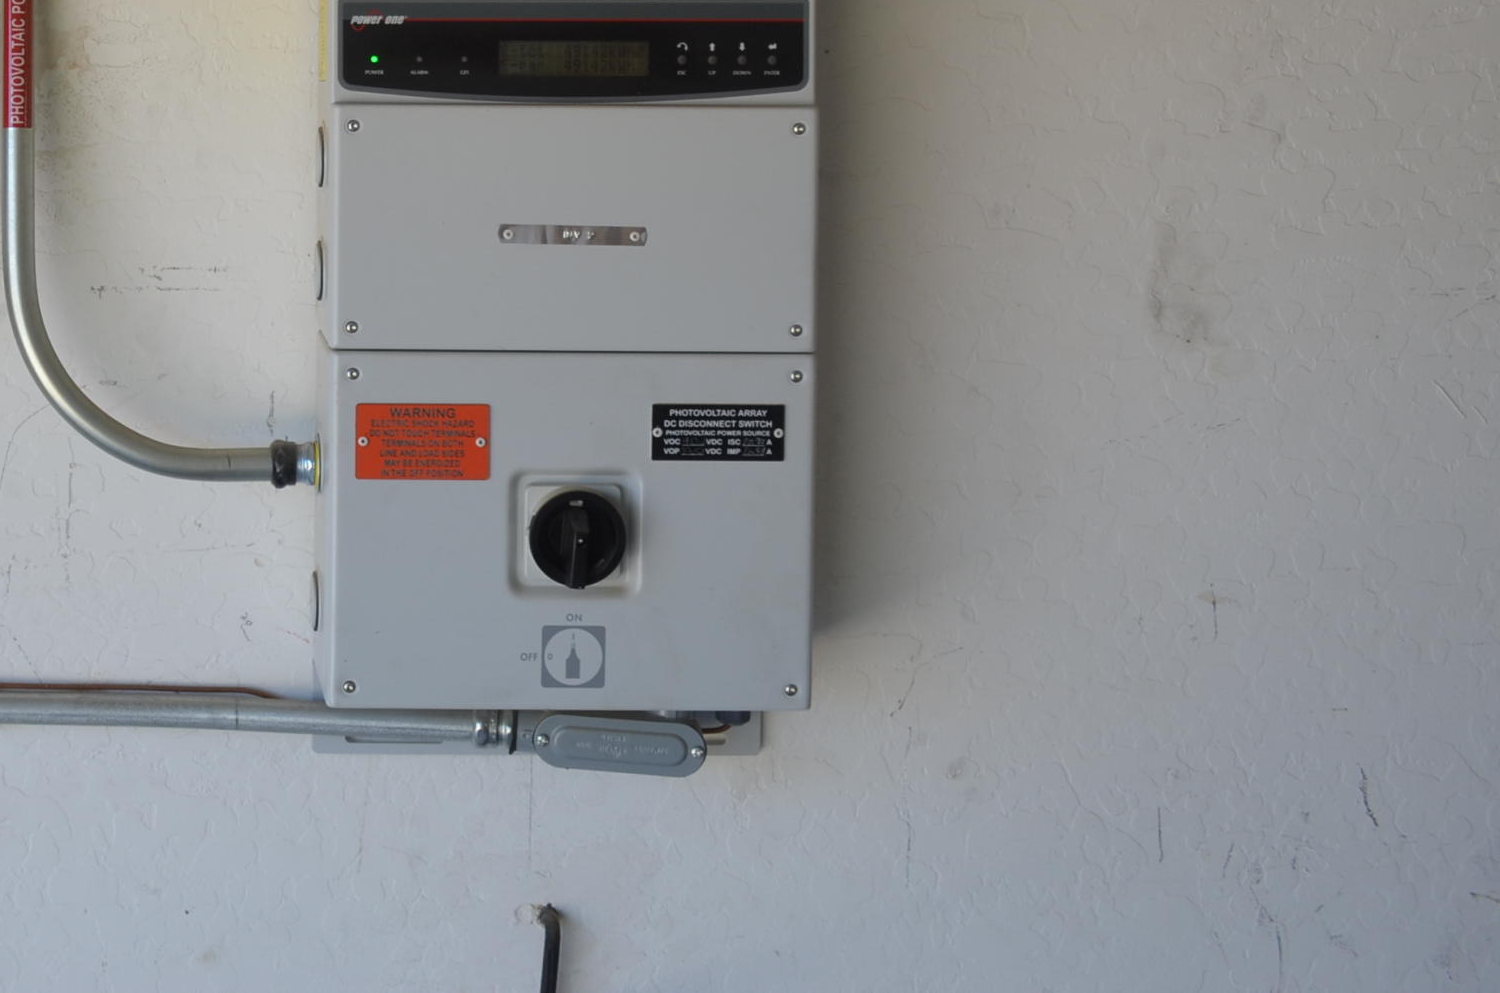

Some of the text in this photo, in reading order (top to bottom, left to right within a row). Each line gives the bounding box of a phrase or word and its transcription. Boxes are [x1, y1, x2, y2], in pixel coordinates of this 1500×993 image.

[11, 19, 25, 124] PHOTOVOLTAIC
[390, 408, 456, 418] WARNING
[566, 613, 582, 622] ON
[520, 652, 538, 661] OFF
